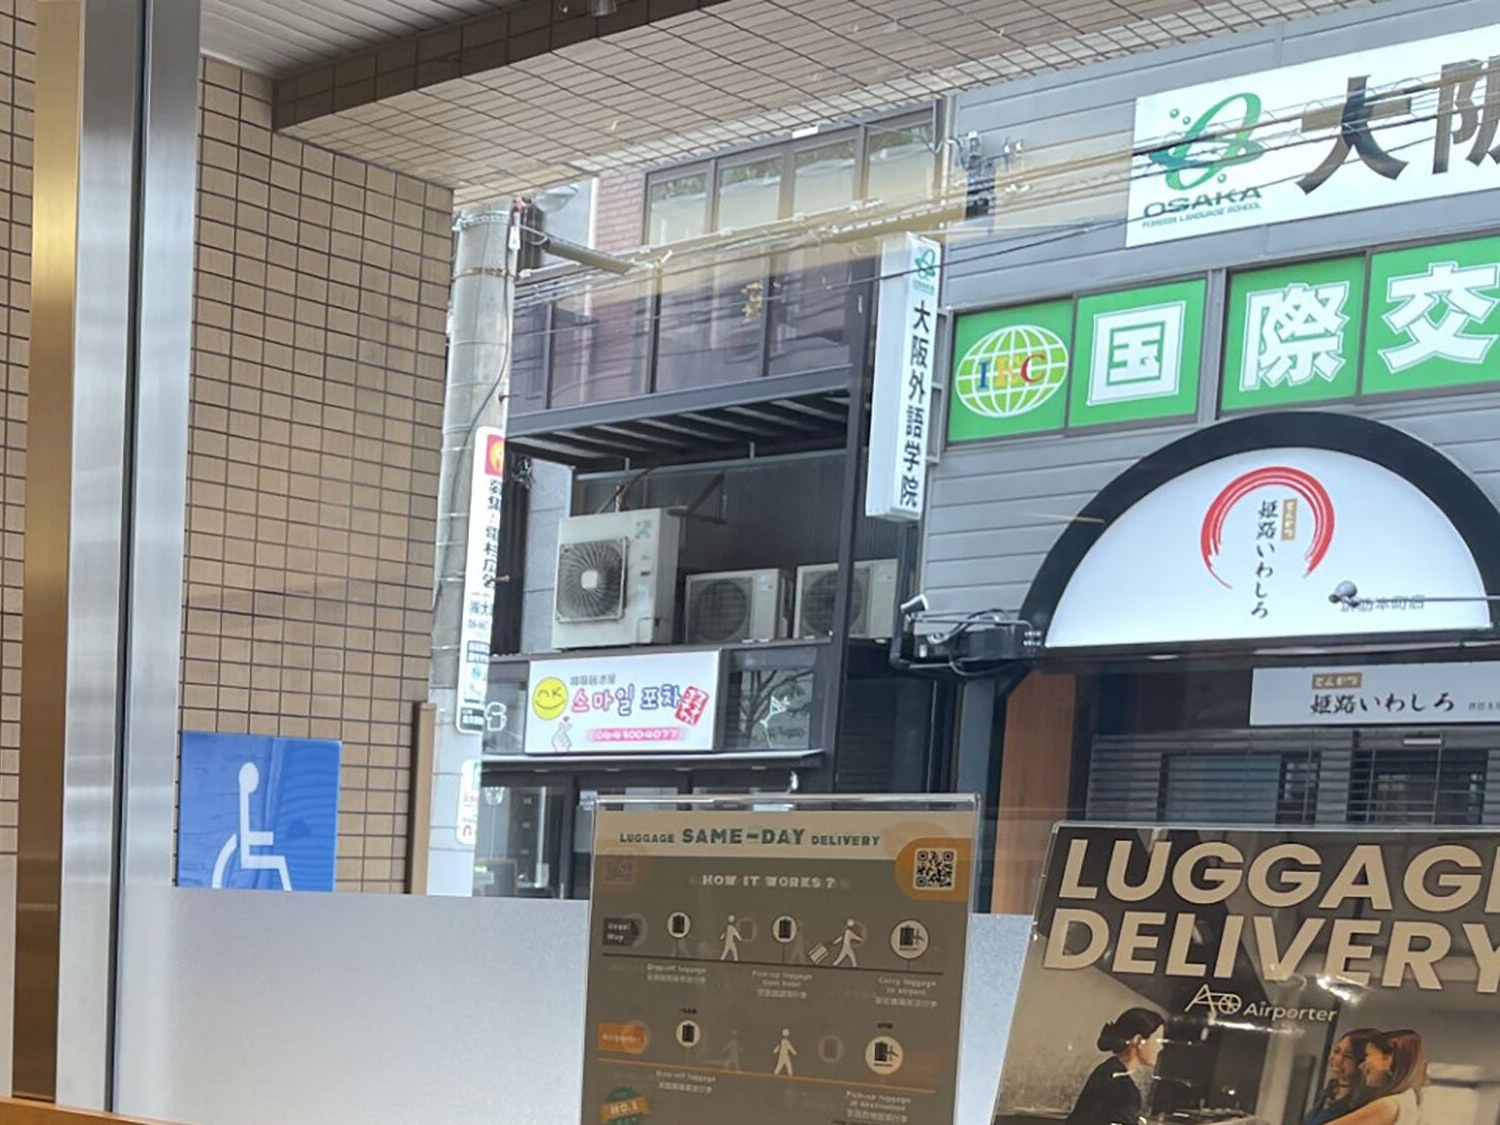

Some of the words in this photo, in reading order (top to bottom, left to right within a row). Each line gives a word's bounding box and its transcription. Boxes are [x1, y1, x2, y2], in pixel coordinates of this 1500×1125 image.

[1143, 187, 1261, 218] OSAKA
[1228, 202, 1261, 213] SCHOOL
[1087, 262, 1500, 405] 国際交
[900, 300, 931, 508] 大阪外語学院
[1251, 500, 1278, 619] 姫路いわしろ
[571, 684, 635, 717] 스마일
[640, 684, 681, 709] 포차
[1310, 692, 1454, 714] 姫路いわしろ
[619, 833, 675, 844] LUGGAGE
[682, 828, 805, 845] SAME-DAY
[811, 835, 880, 847] DELIVERY
[702, 875, 736, 886] HOW
[743, 875, 760, 886] IT
[1057, 838, 1500, 914] LUGGAG
[1042, 906, 1500, 994] DELIVERY
[1243, 1002, 1337, 1022] Airporter
